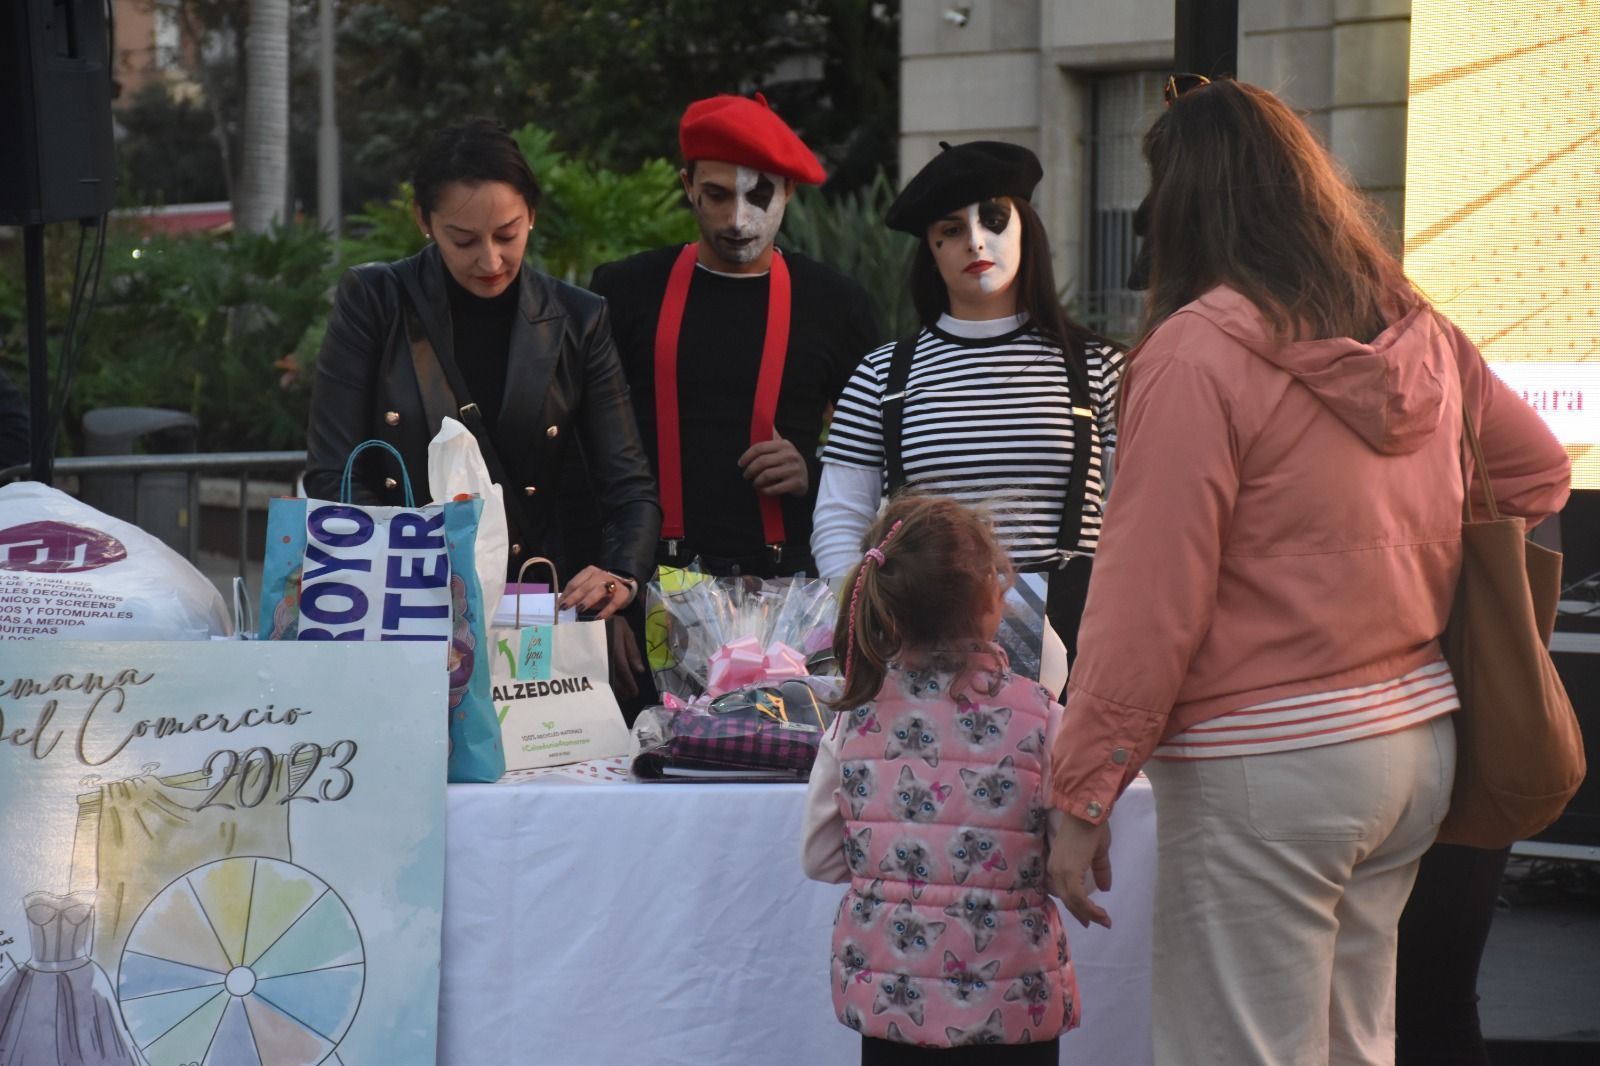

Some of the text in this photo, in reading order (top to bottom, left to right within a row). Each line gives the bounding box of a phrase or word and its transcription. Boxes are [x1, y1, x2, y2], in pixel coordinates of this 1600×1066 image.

[33, 589, 124, 602] DECORATIVOS
[56, 599, 117, 609] SCREENS
[26, 606, 35, 615] Y
[37, 608, 134, 619] FOTOMURALES
[36, 618, 86, 626] MEDIDA
[492, 676, 594, 702] ALZEDONIA
[74, 686, 313, 767] Comercio
[194, 739, 358, 813] 2023
